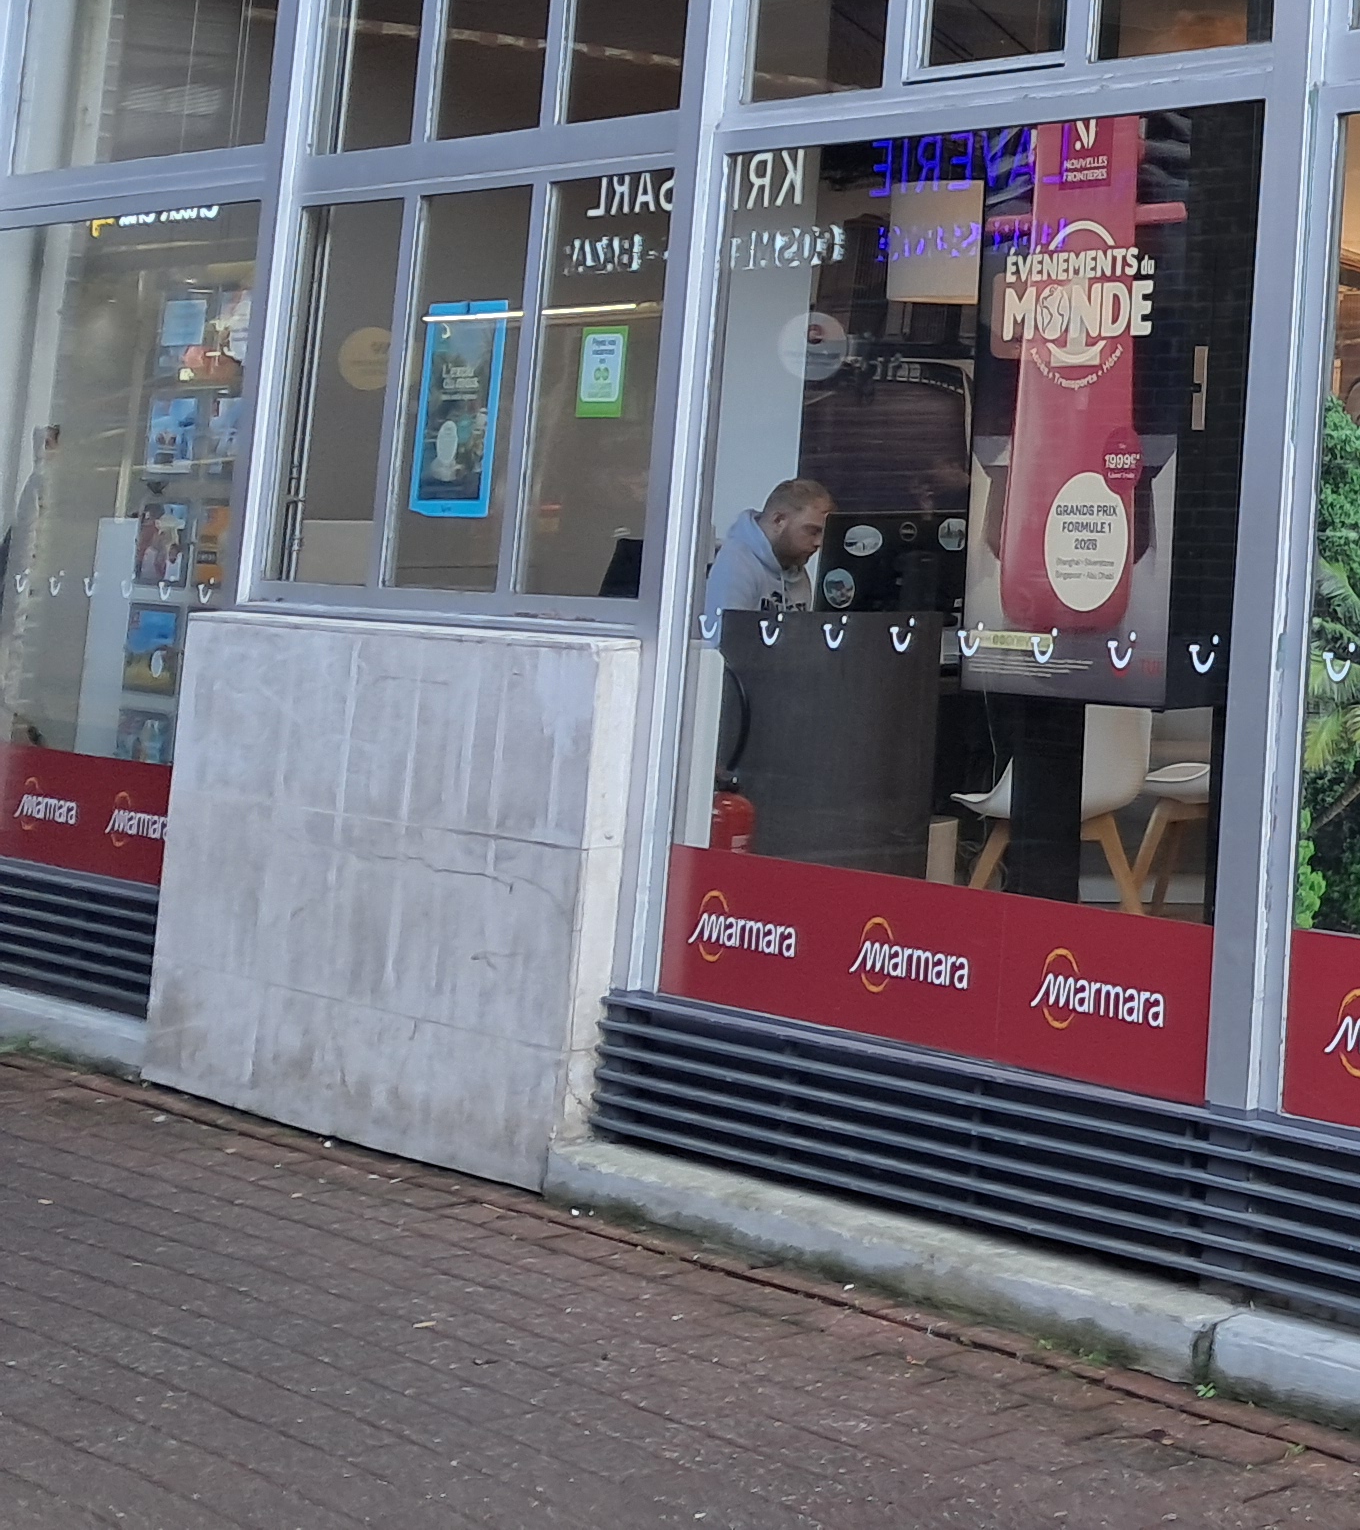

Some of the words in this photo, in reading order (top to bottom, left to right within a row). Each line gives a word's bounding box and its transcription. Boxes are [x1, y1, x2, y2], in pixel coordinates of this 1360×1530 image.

[1006, 247, 1138, 283] ÉVÉNEMENTS
[1140, 254, 1155, 275] du
[1002, 280, 1154, 342] MONDE
[1055, 504, 1095, 516] GRANDS
[1097, 504, 1118, 517] PRIX
[1062, 521, 1106, 534] FORMULE
[13, 793, 77, 825] Marmara
[688, 913, 796, 959] Marmara
[848, 940, 970, 990] Marmara
[1030, 972, 1165, 1028] Marmara
